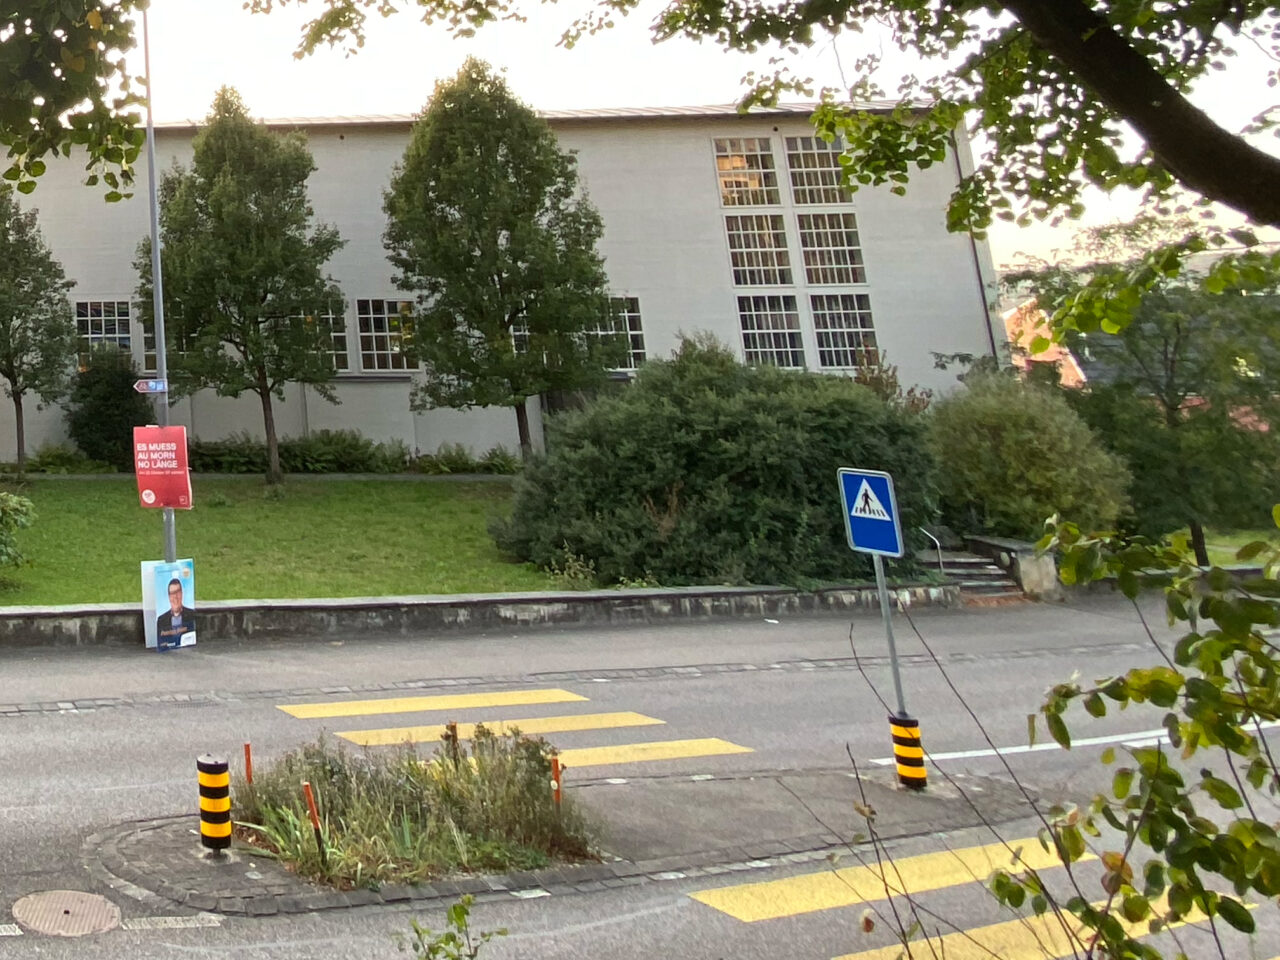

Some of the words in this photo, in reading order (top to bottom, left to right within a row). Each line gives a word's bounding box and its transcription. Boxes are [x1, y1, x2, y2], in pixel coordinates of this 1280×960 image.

[137, 443, 147, 451] ES
[149, 443, 176, 451] MUESS
[138, 451, 149, 460] AU
[150, 451, 175, 459] MORN
[138, 460, 150, 469] NO
[151, 459, 178, 469] LÄNGE
